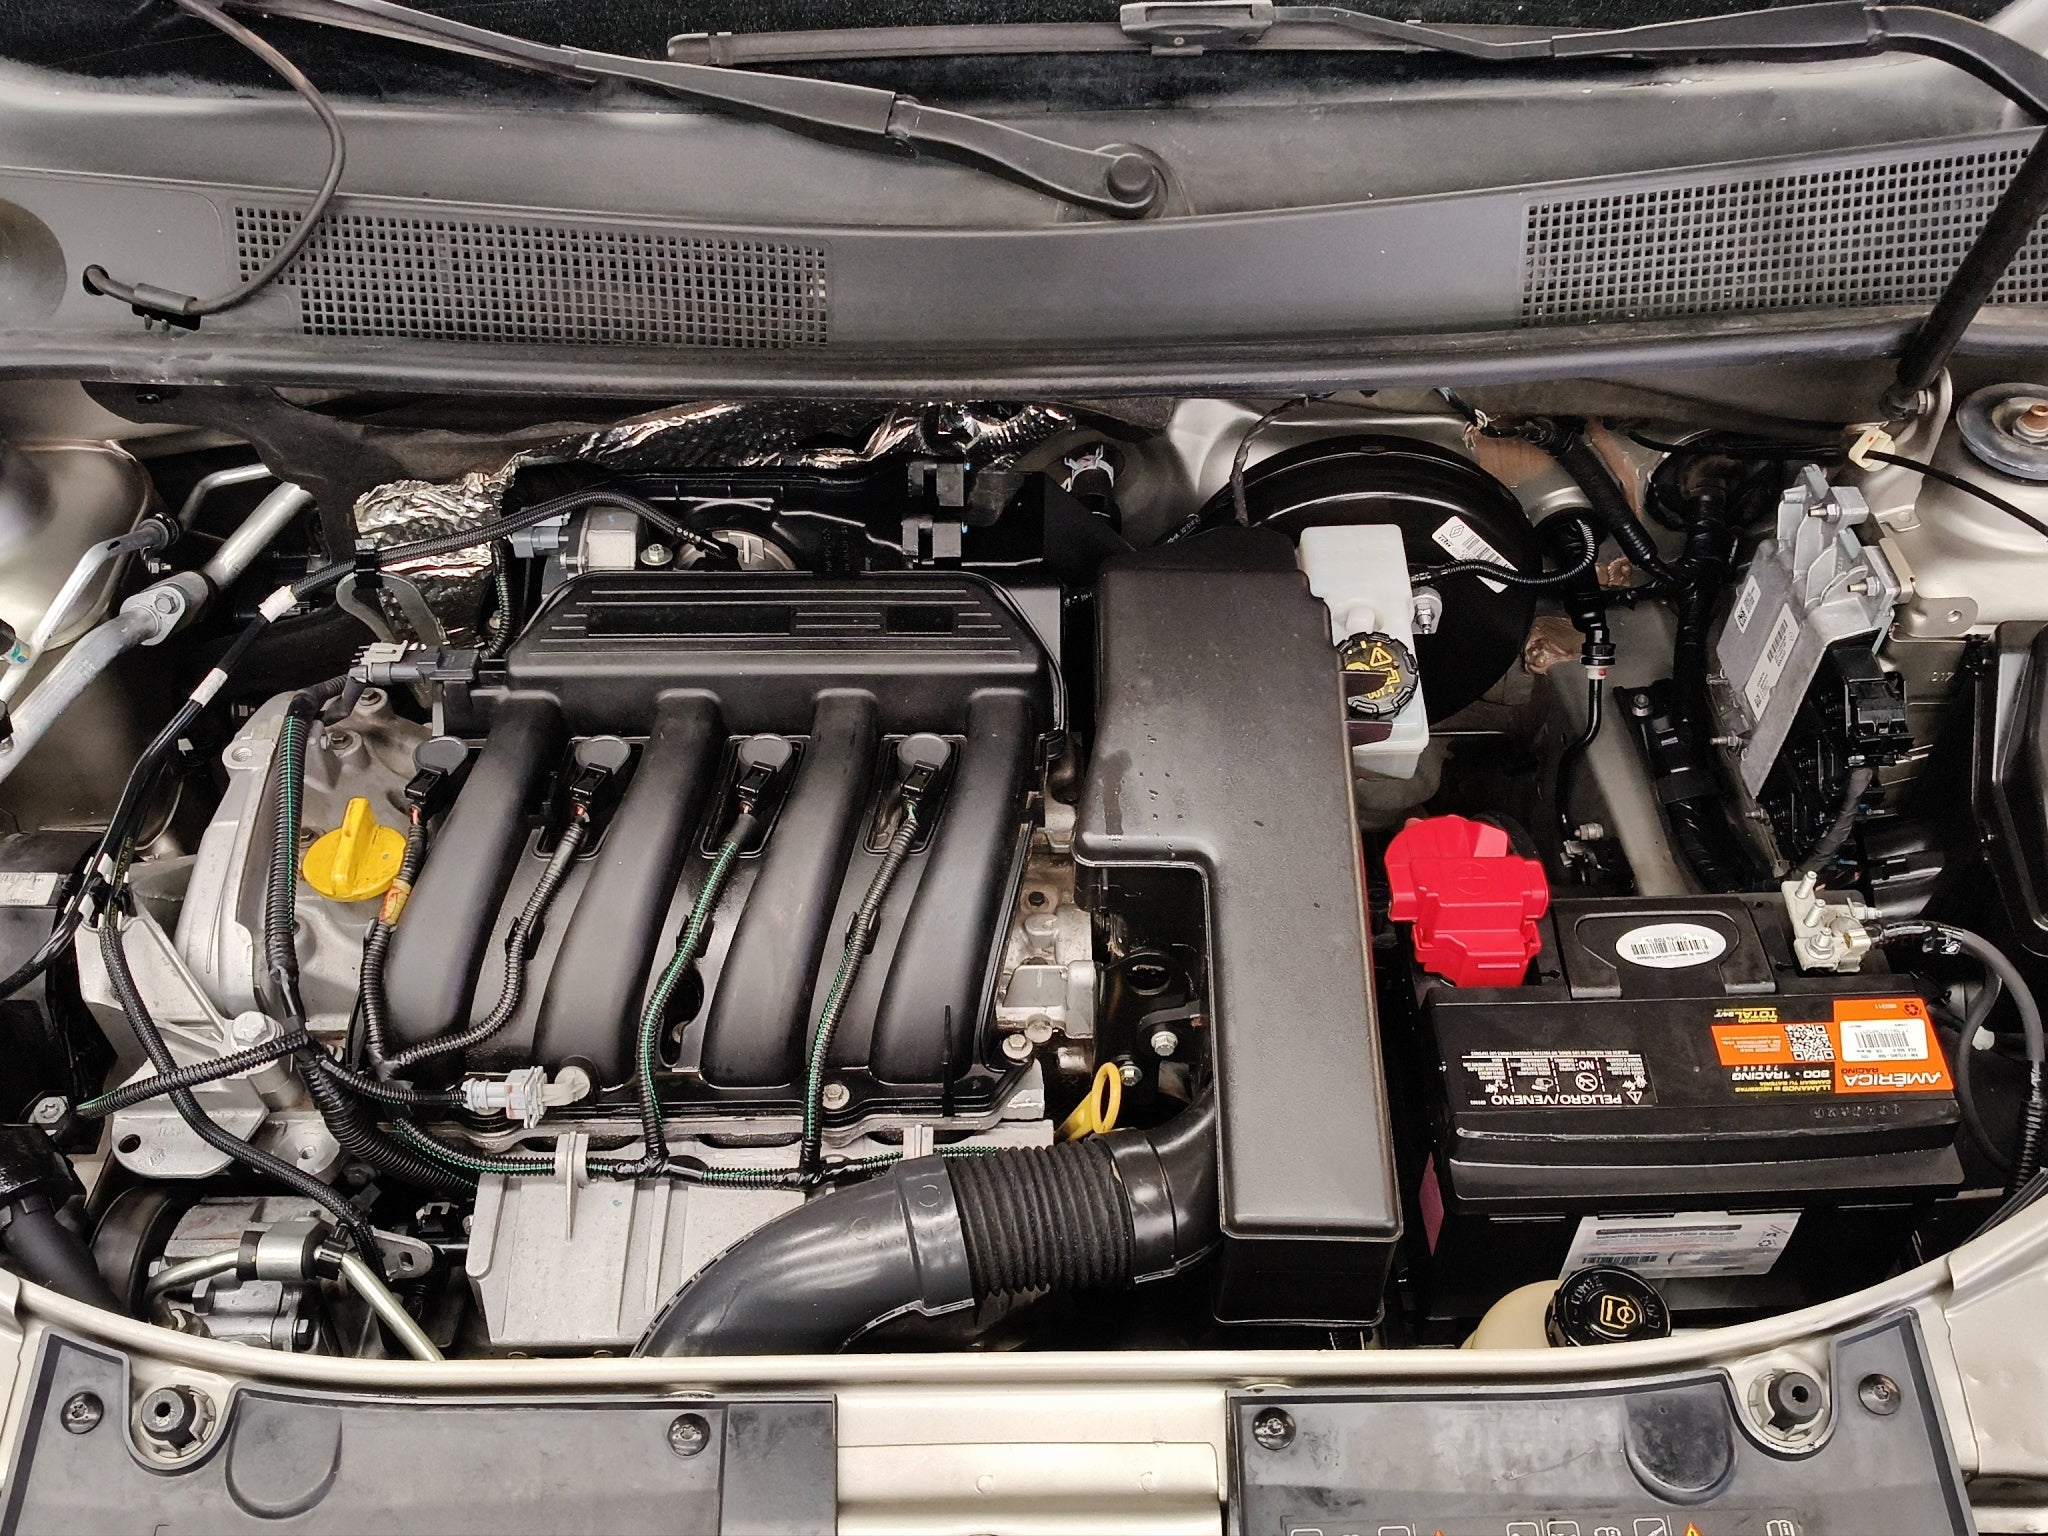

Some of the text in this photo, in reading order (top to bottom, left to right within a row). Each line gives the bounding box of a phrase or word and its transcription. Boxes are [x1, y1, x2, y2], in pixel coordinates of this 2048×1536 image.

[1735, 1011, 1778, 1019] TOTAL
[1731, 1070, 1791, 1081] 1RACING
[1803, 1070, 1830, 1079] 800
[1843, 1071, 1943, 1088] AMÉRICA
[1491, 1094, 1623, 1106] PELIGRO/VENENO
